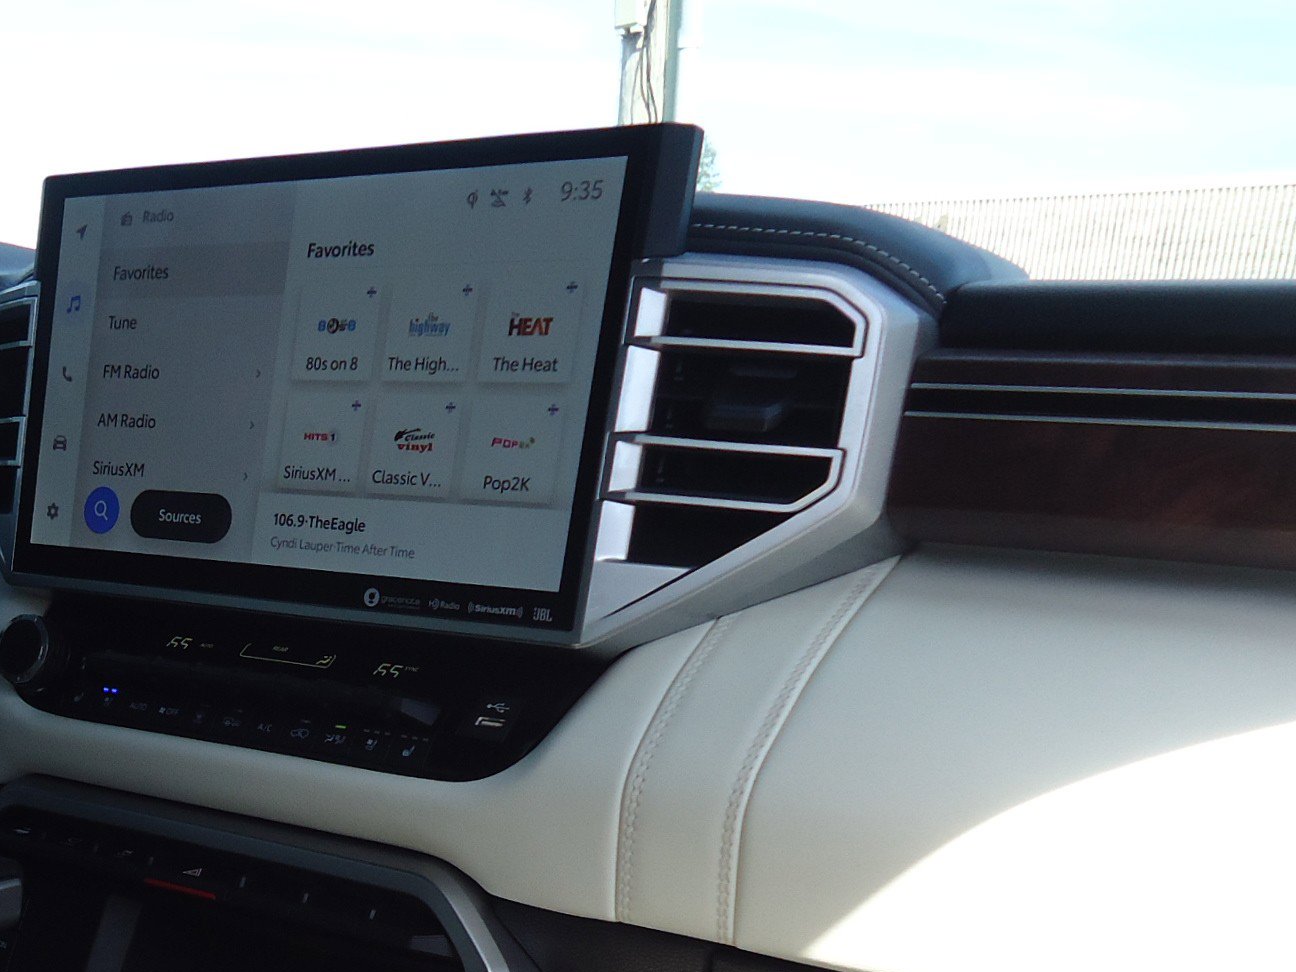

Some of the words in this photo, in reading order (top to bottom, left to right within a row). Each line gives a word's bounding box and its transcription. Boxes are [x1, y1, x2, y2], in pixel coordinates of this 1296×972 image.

[560, 180, 604, 202] 9:35
[142, 210, 174, 223] Radio
[307, 241, 375, 258] Favorites
[113, 265, 169, 281] Favorites
[109, 316, 137, 330] Tune
[508, 317, 554, 336] HEAT
[306, 357, 328, 371] 80s
[331, 360, 347, 371] on
[349, 356, 359, 371] 8
[388, 357, 412, 372] The
[493, 357, 520, 372] The
[522, 356, 558, 372] Heat
[103, 365, 123, 379] FM
[124, 365, 160, 380] Radio
[97, 414, 118, 428] AM
[120, 414, 156, 429] Radio
[304, 432, 328, 442] HITS
[330, 432, 336, 442] 1
[397, 441, 433, 453] vinyl
[93, 461, 145, 478] SiriusXM
[283, 465, 336, 482] SiriusXM
[372, 469, 417, 486] Classic
[483, 476, 530, 492] Pop2K
[158, 509, 202, 524] Sources
[270, 536, 297, 550] Cyndi
[336, 542, 360, 554] Time
[362, 543, 388, 556] After
[390, 545, 415, 559] Time
[441, 600, 460, 611] Radio
[533, 607, 553, 622] JBL
